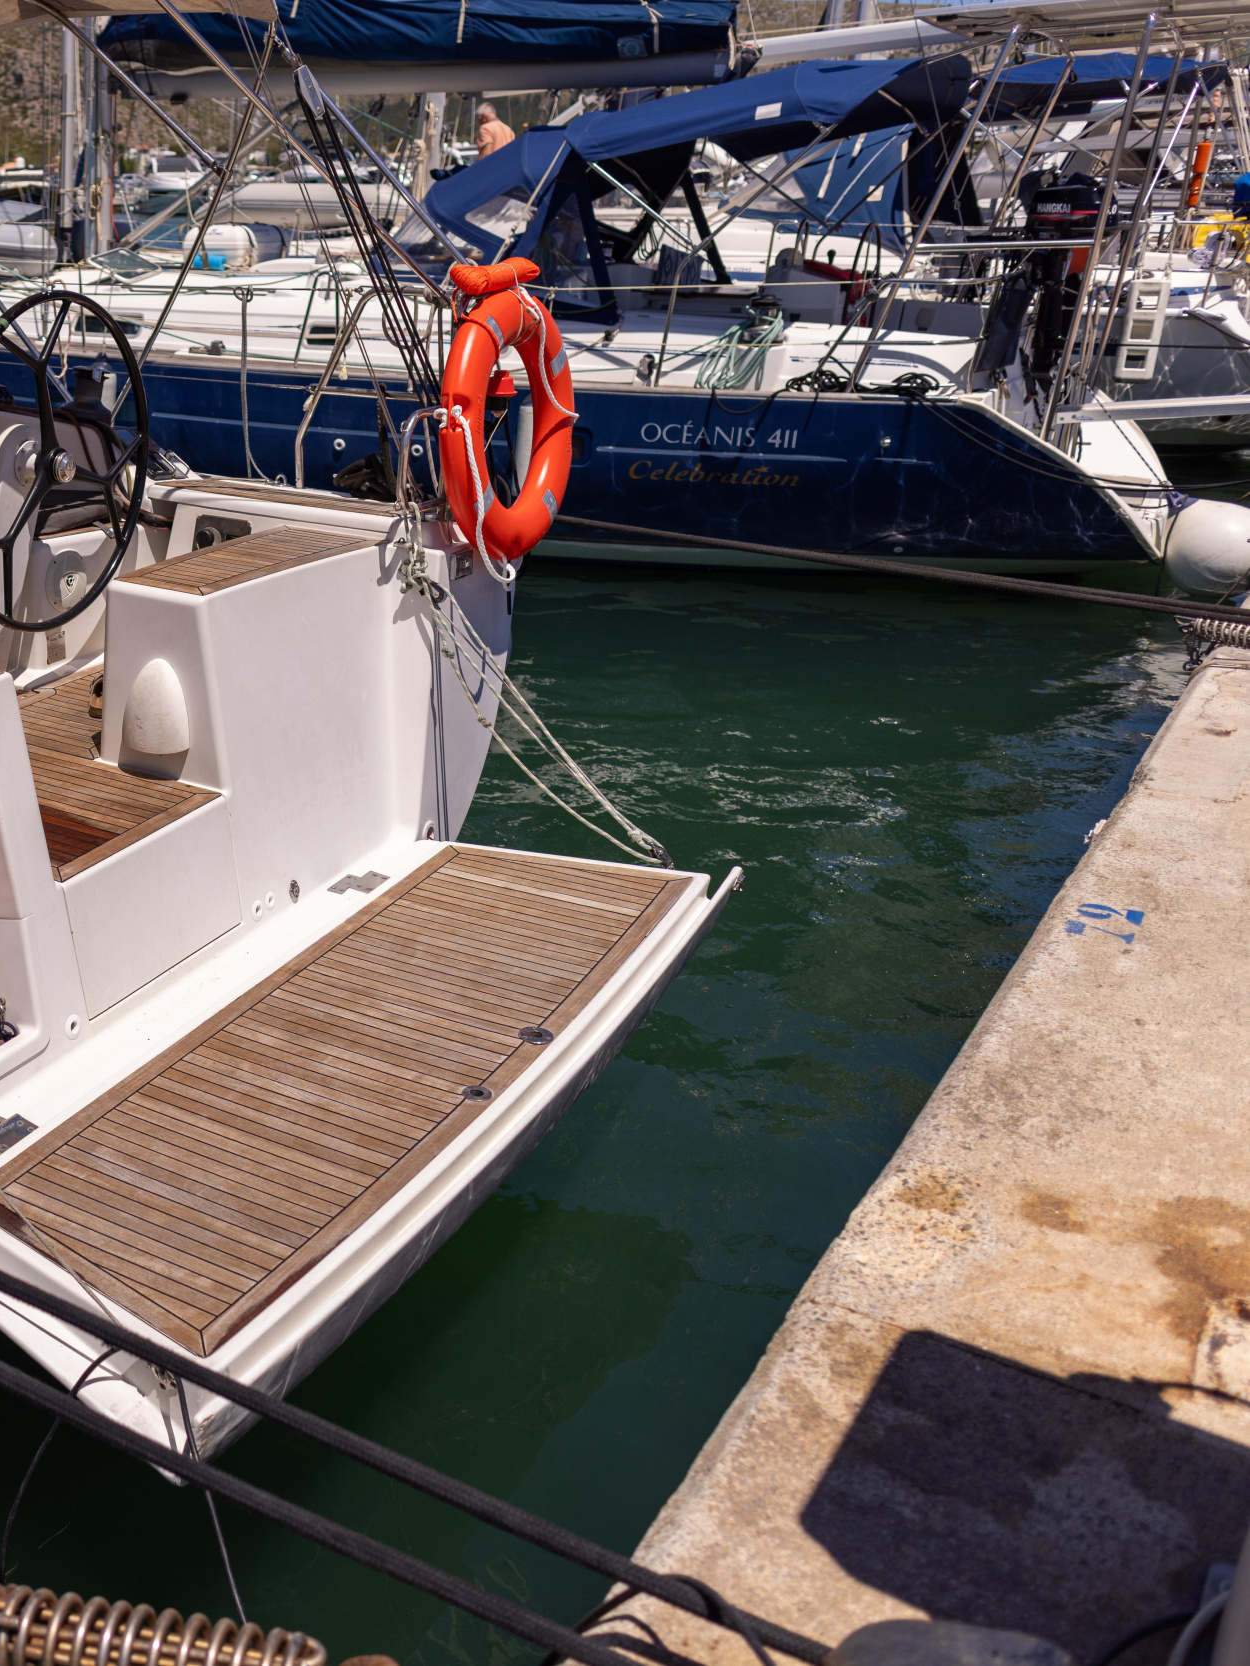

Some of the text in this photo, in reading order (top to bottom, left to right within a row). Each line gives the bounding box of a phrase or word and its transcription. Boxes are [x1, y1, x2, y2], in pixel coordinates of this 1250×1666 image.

[1037, 202, 1071, 213] HANGKAI
[641, 420, 798, 448] OCÉANIS 411
[628, 460, 799, 487] Celebration
